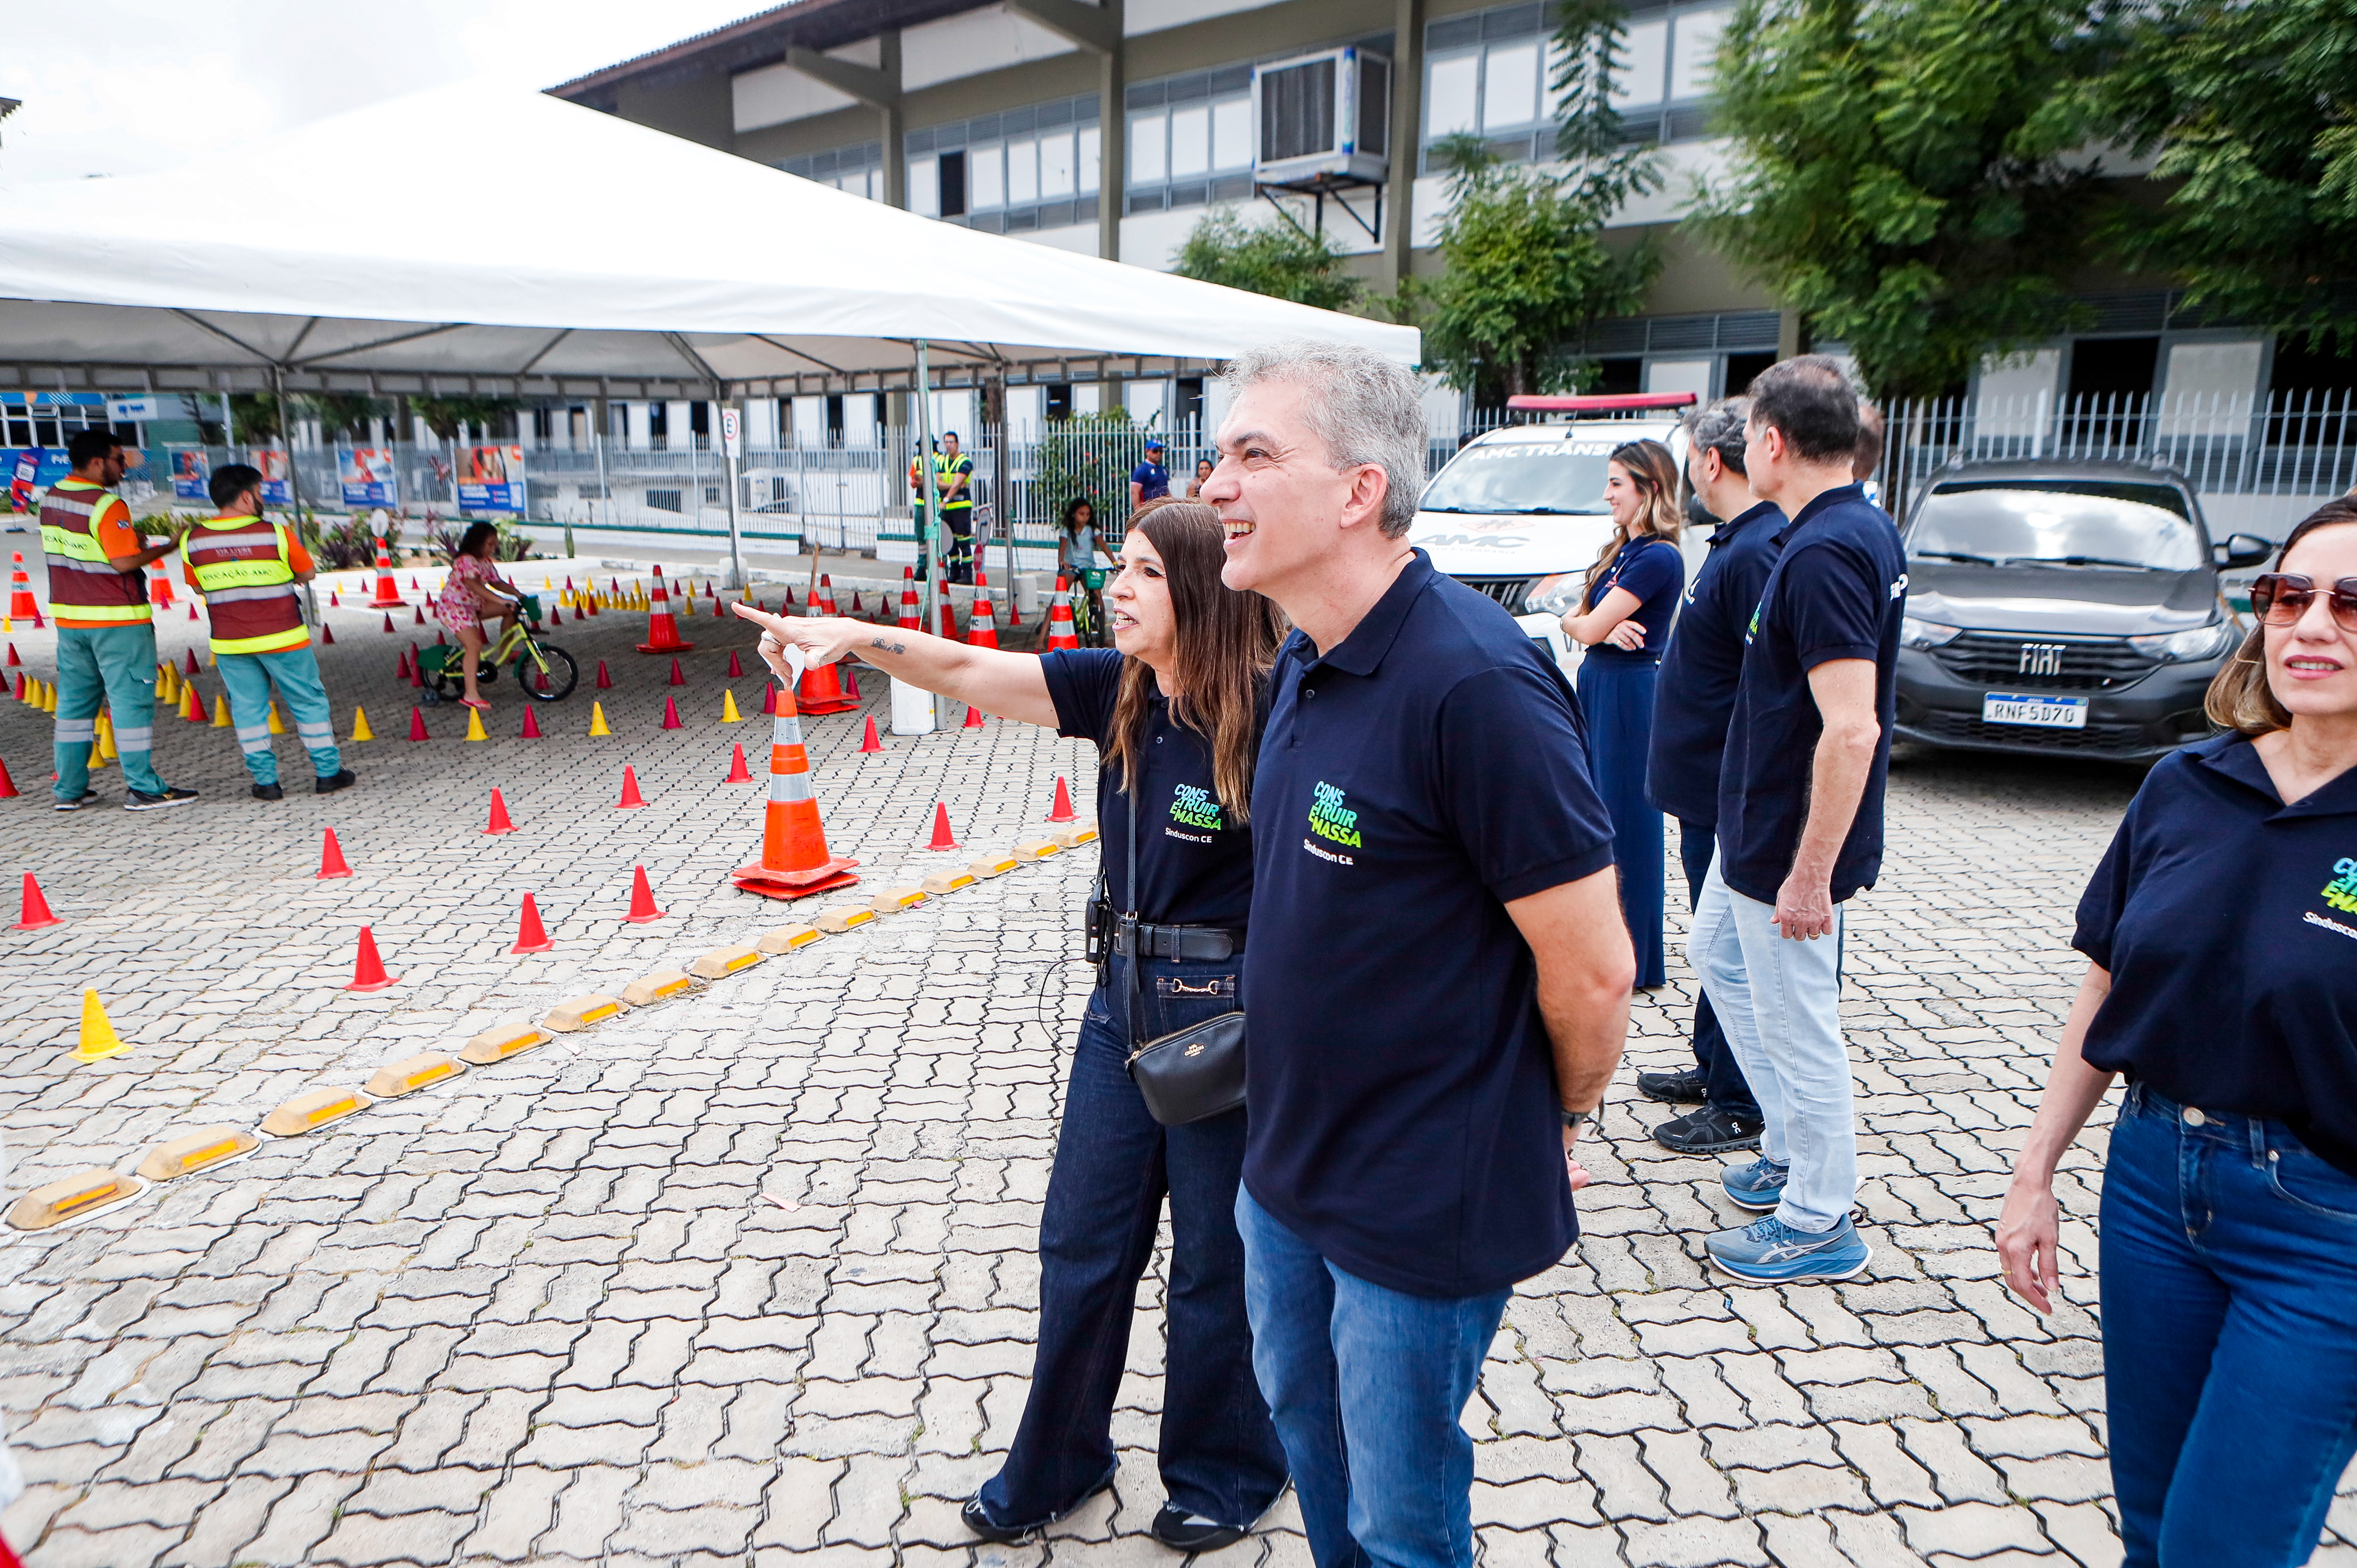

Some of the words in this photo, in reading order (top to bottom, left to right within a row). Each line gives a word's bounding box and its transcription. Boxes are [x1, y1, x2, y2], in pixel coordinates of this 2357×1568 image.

[727, 418, 733, 433] E
[1468, 446, 1518, 461] AMC
[1525, 440, 1618, 457] TRÂNSI
[1411, 534, 1531, 548] AMC
[2019, 643, 2067, 676] FIAT
[1994, 704, 2076, 723] RNF5D70
[1174, 783, 1210, 802] CONS
[1313, 780, 1346, 807] CONS
[1178, 796, 1220, 817] TRUIR
[1316, 799, 1358, 829] TRUIR
[1173, 809, 1221, 830] MASSA
[1165, 827, 1199, 842] Sinduscon
[1311, 815, 1361, 848] MASSA
[1303, 838, 1337, 862] Sinduscon
[1338, 854, 1353, 865] CE
[2302, 911, 2357, 940] Sindusco
